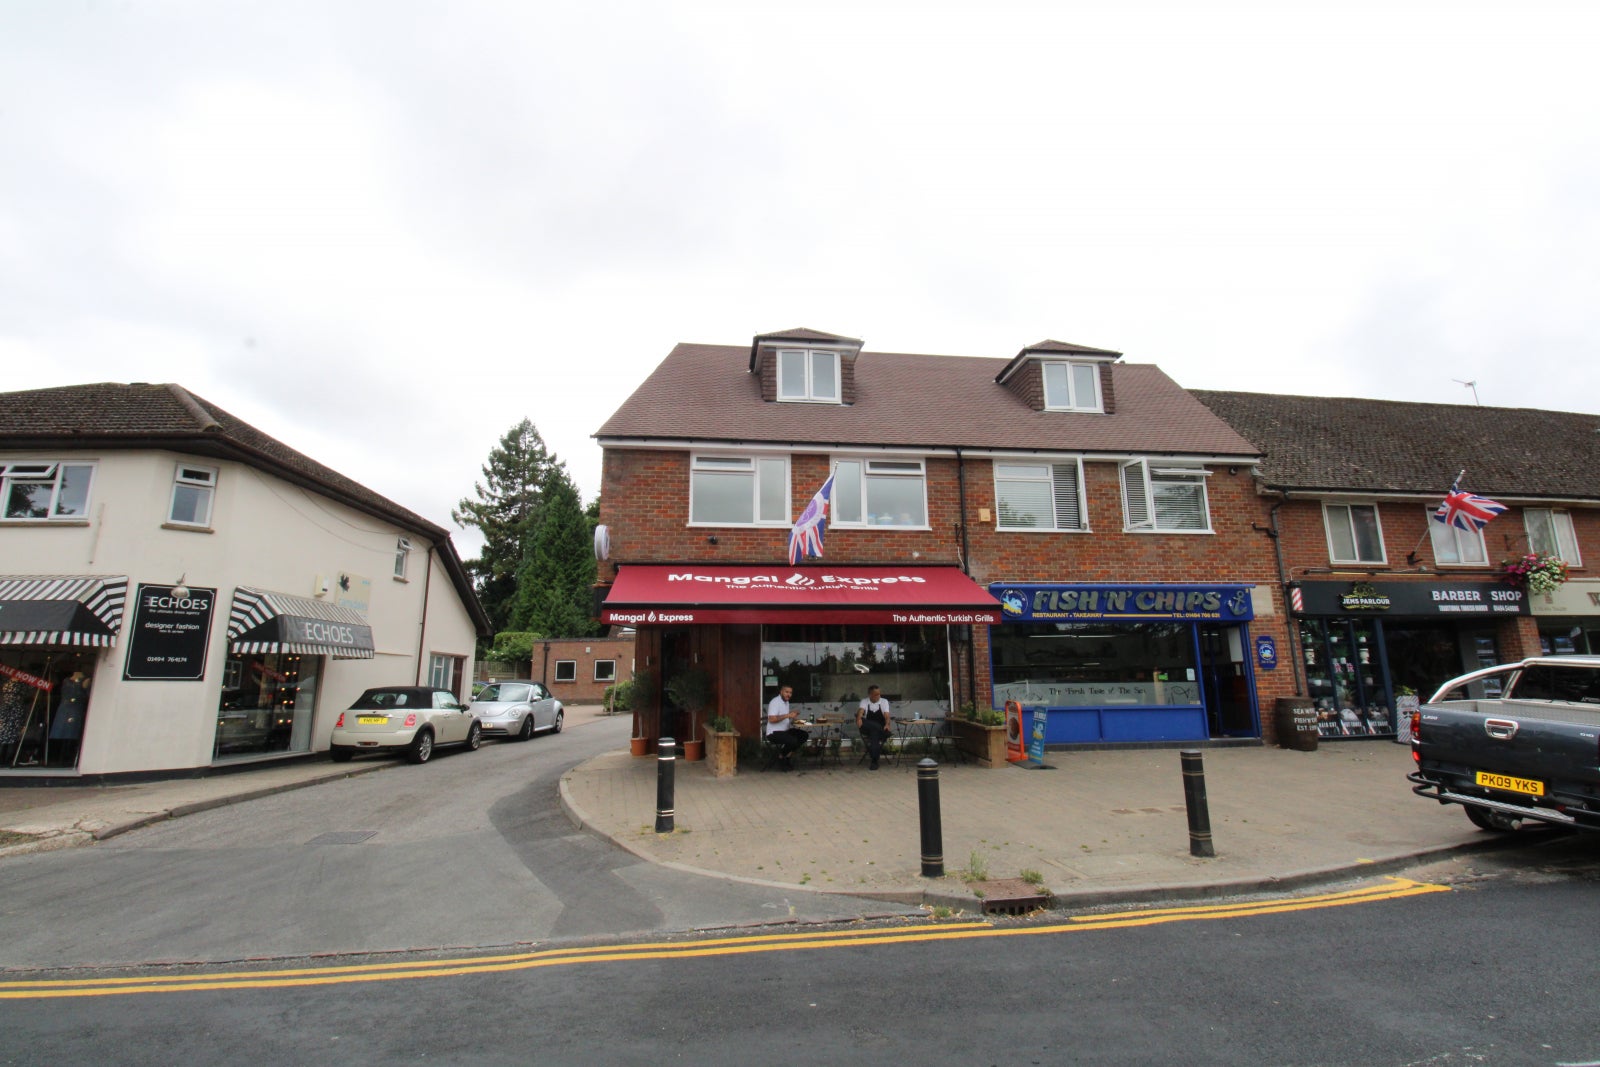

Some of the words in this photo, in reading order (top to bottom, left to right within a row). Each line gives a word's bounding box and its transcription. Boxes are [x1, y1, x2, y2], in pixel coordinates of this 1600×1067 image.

[668, 573, 779, 584] Mangal
[821, 575, 926, 585] Express
[1032, 590, 1099, 611] FISH
[1135, 591, 1221, 611] CHIPS
[1431, 590, 1481, 601] BARBER
[1490, 590, 1522, 601] SHOP
[149, 596, 208, 610] ECHOES
[609, 613, 646, 623] Mangal
[659, 613, 694, 623] Express
[893, 614, 907, 622] The
[909, 614, 946, 622] Authentic
[947, 614, 973, 622] Turkish
[974, 614, 994, 622] Grills
[145, 622, 174, 630] designer
[176, 622, 200, 630] fashion
[305, 622, 354, 644] ECHOES
[0, 664, 15, 676] ALE
[15, 671, 38, 683] NOW
[37, 679, 50, 689] ON
[1049, 687, 1062, 696] The
[1119, 687, 1132, 695] The
[1481, 774, 1511, 788] PK09
[1515, 780, 1538, 792] YKS
